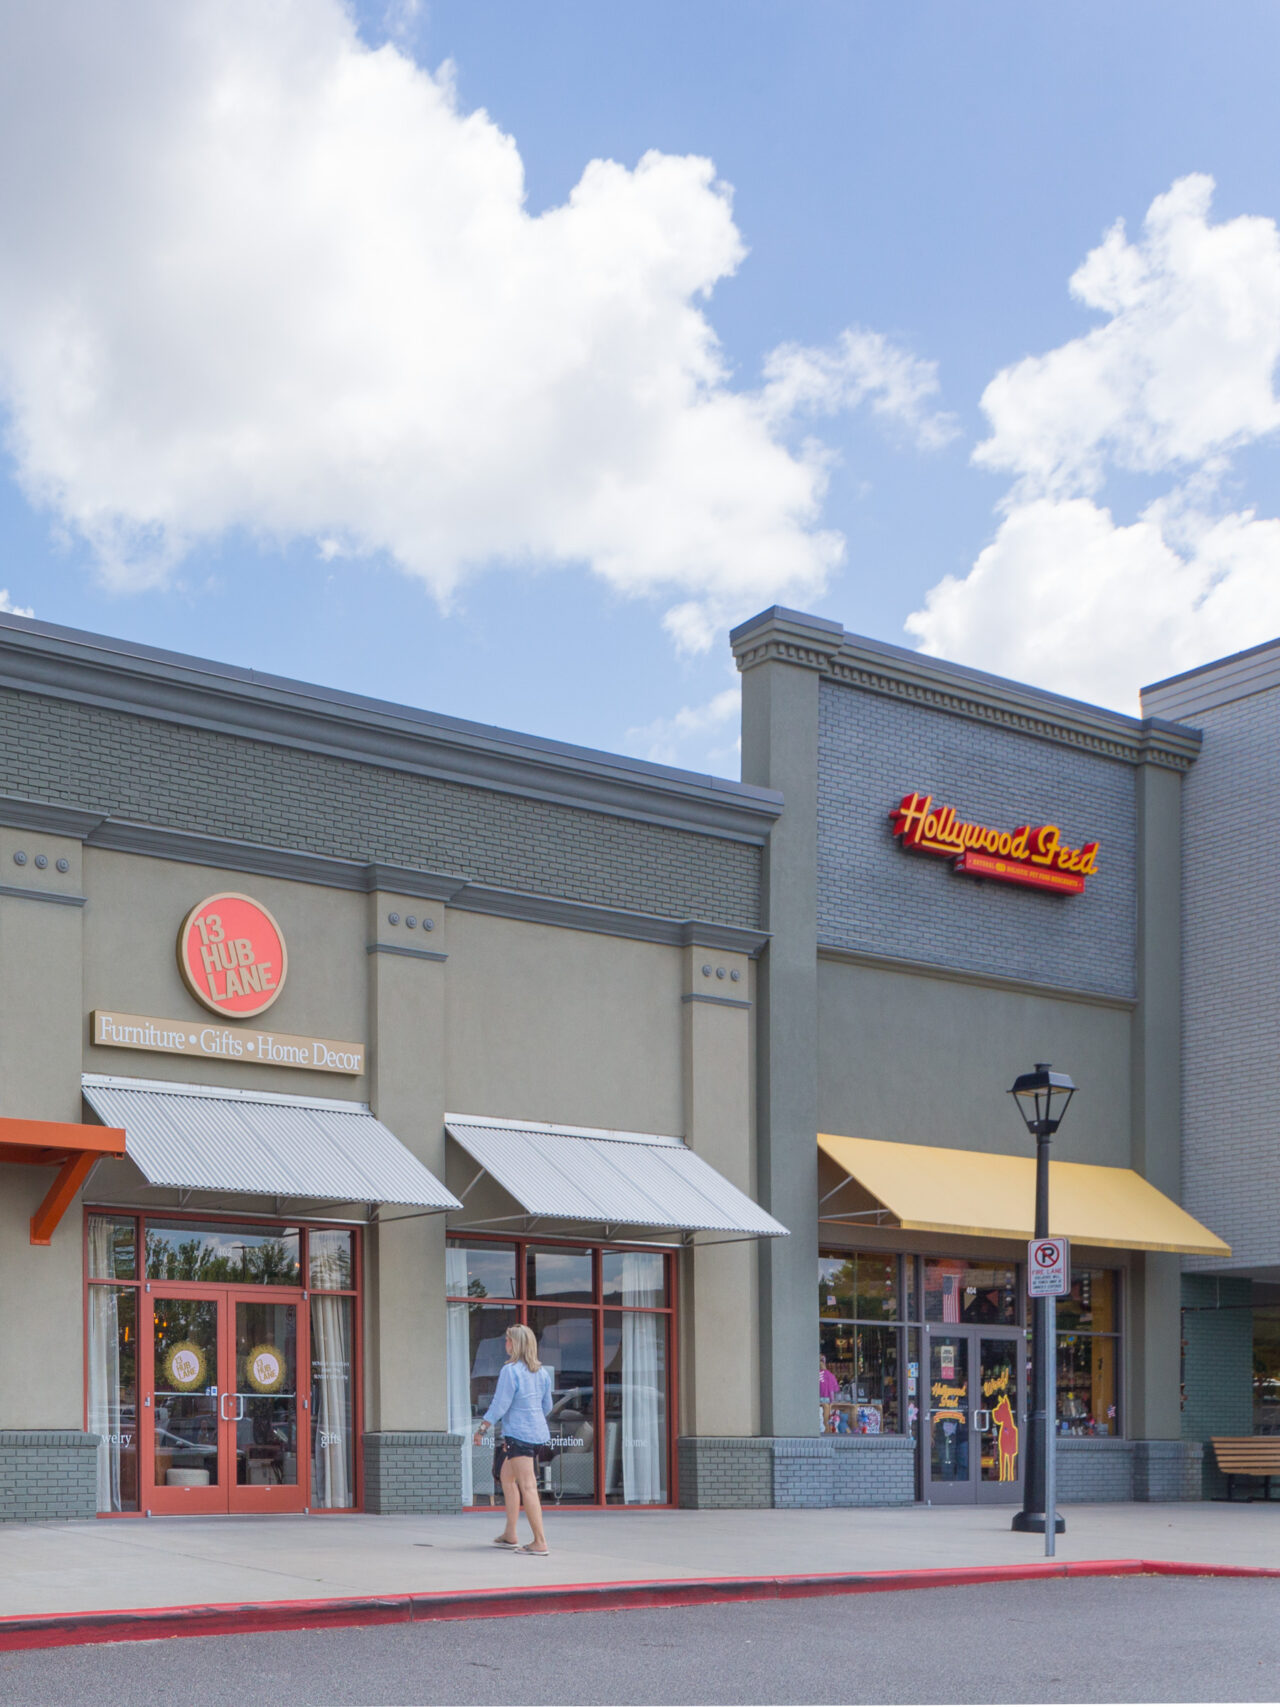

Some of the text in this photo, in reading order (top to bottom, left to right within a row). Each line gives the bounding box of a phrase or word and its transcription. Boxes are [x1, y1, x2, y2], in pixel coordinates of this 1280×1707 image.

[900, 792, 1100, 875] Hollywood Feed
[193, 914, 225, 945] 13
[200, 938, 256, 974] HUB
[206, 961, 277, 1002] LANE
[99, 1015, 361, 1071] Furniture Gifts Home Decor
[178, 1367, 197, 1380] LANE
[320, 1432, 342, 1448] gifts
